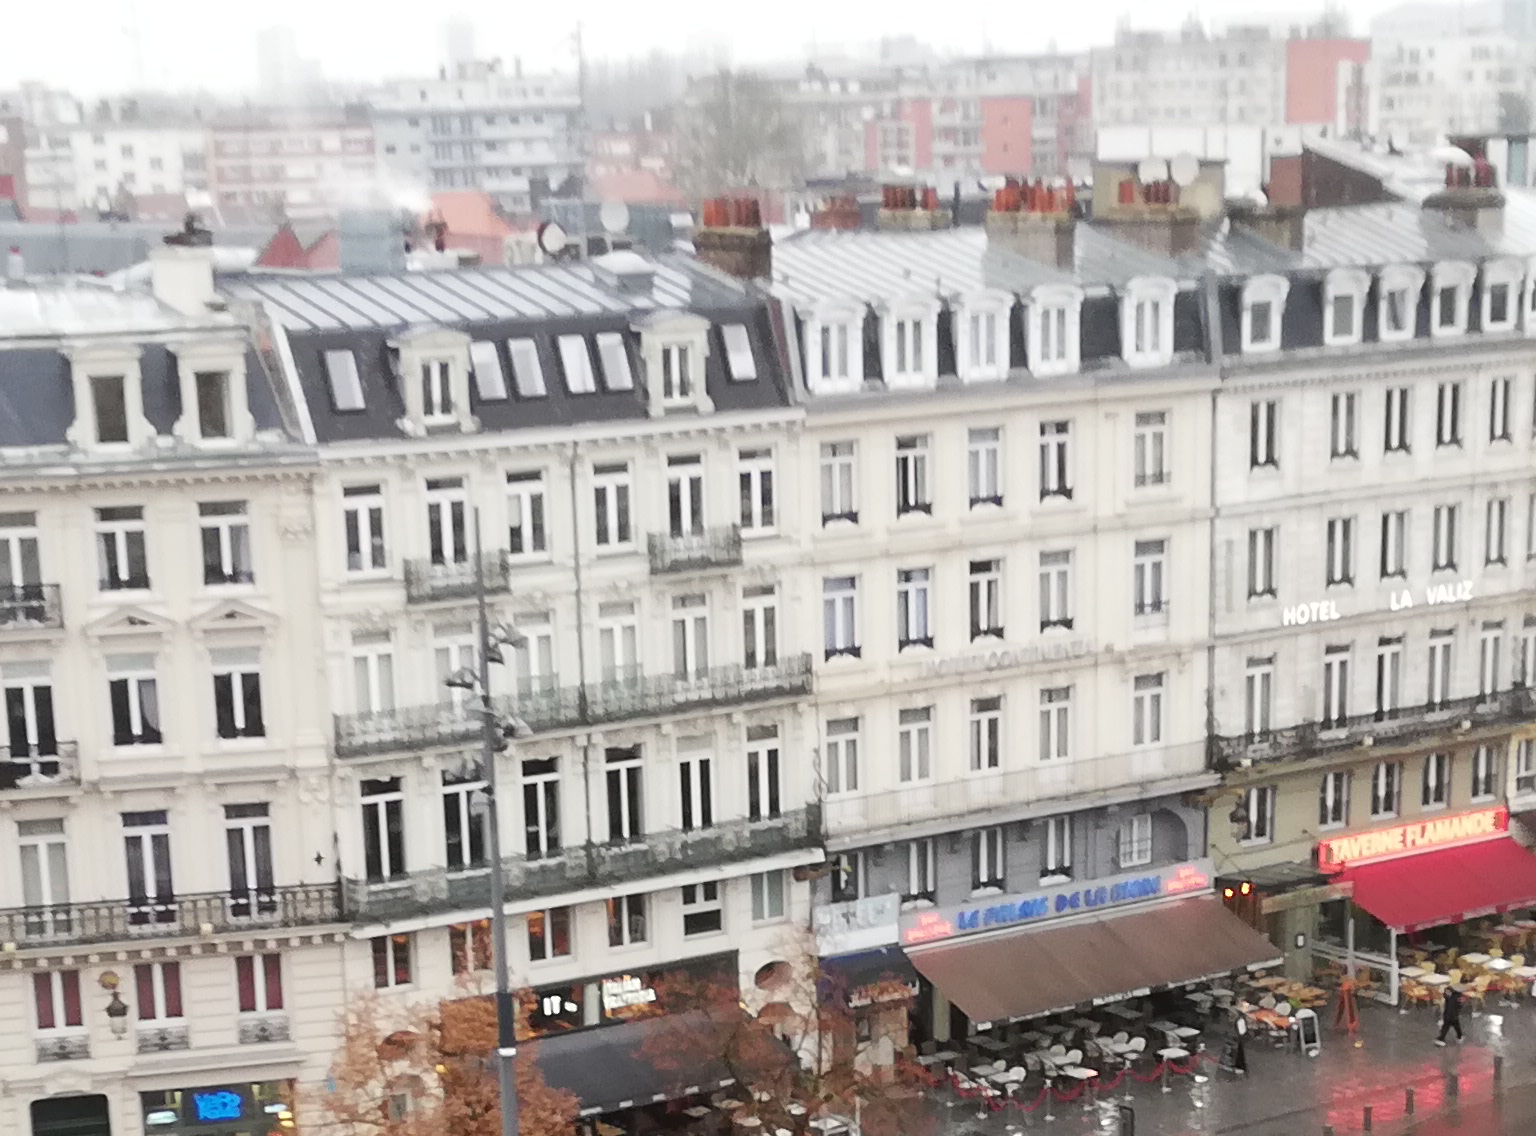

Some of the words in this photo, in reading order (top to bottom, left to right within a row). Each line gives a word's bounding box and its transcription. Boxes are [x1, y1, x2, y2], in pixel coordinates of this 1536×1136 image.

[1283, 598, 1341, 626] HOTEL
[1390, 589, 1413, 611] LA
[1426, 580, 1474, 605] VALIZ
[1331, 827, 1404, 863] TAVERNE
[1406, 811, 1495, 848] FLAMANDE
